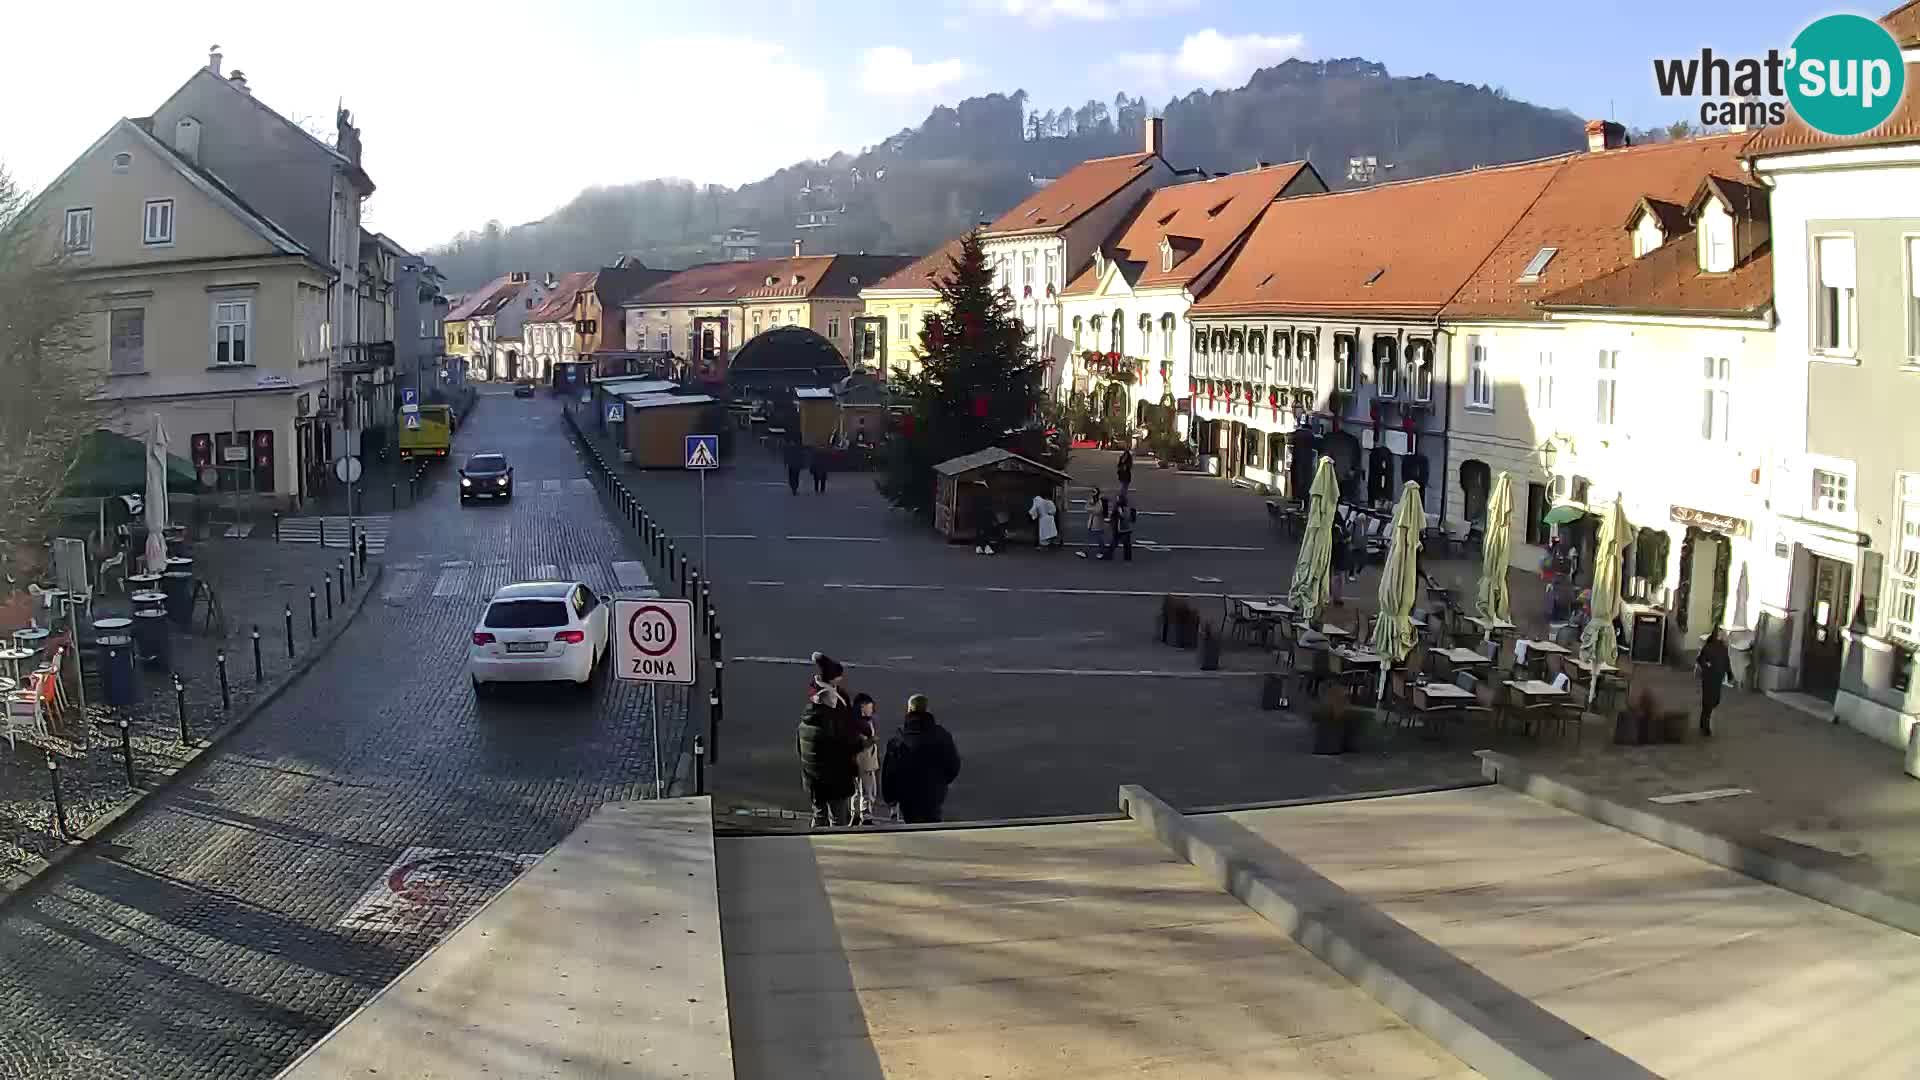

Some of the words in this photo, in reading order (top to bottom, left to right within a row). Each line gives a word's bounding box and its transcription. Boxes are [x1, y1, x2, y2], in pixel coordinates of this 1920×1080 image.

[406, 391, 414, 401] P
[641, 621, 665, 642] 30
[632, 659, 676, 675] ZONA
